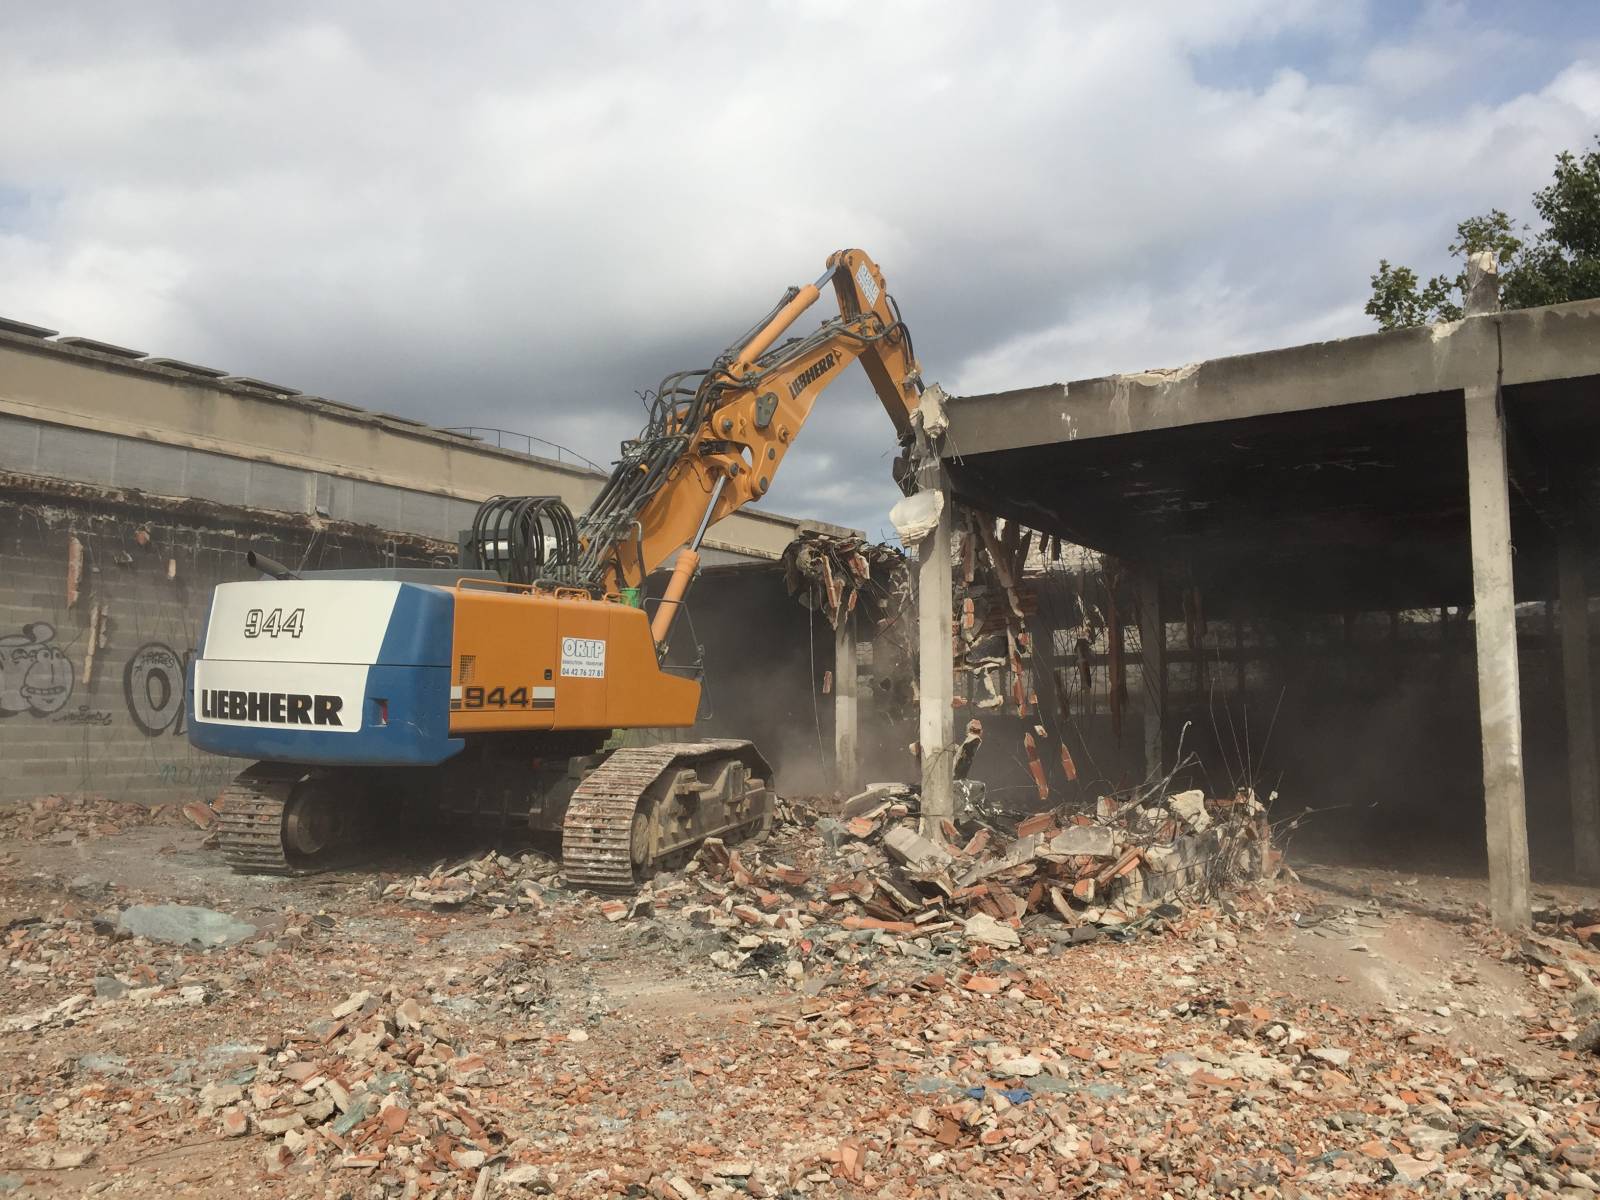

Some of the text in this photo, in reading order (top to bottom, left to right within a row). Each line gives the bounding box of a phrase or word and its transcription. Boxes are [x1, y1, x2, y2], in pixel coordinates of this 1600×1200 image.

[788, 352, 836, 401] LIEBHERR
[243, 608, 305, 639] 944
[563, 639, 604, 658] ORTP
[201, 689, 343, 727] LIEBHERR
[464, 687, 530, 708] 944
